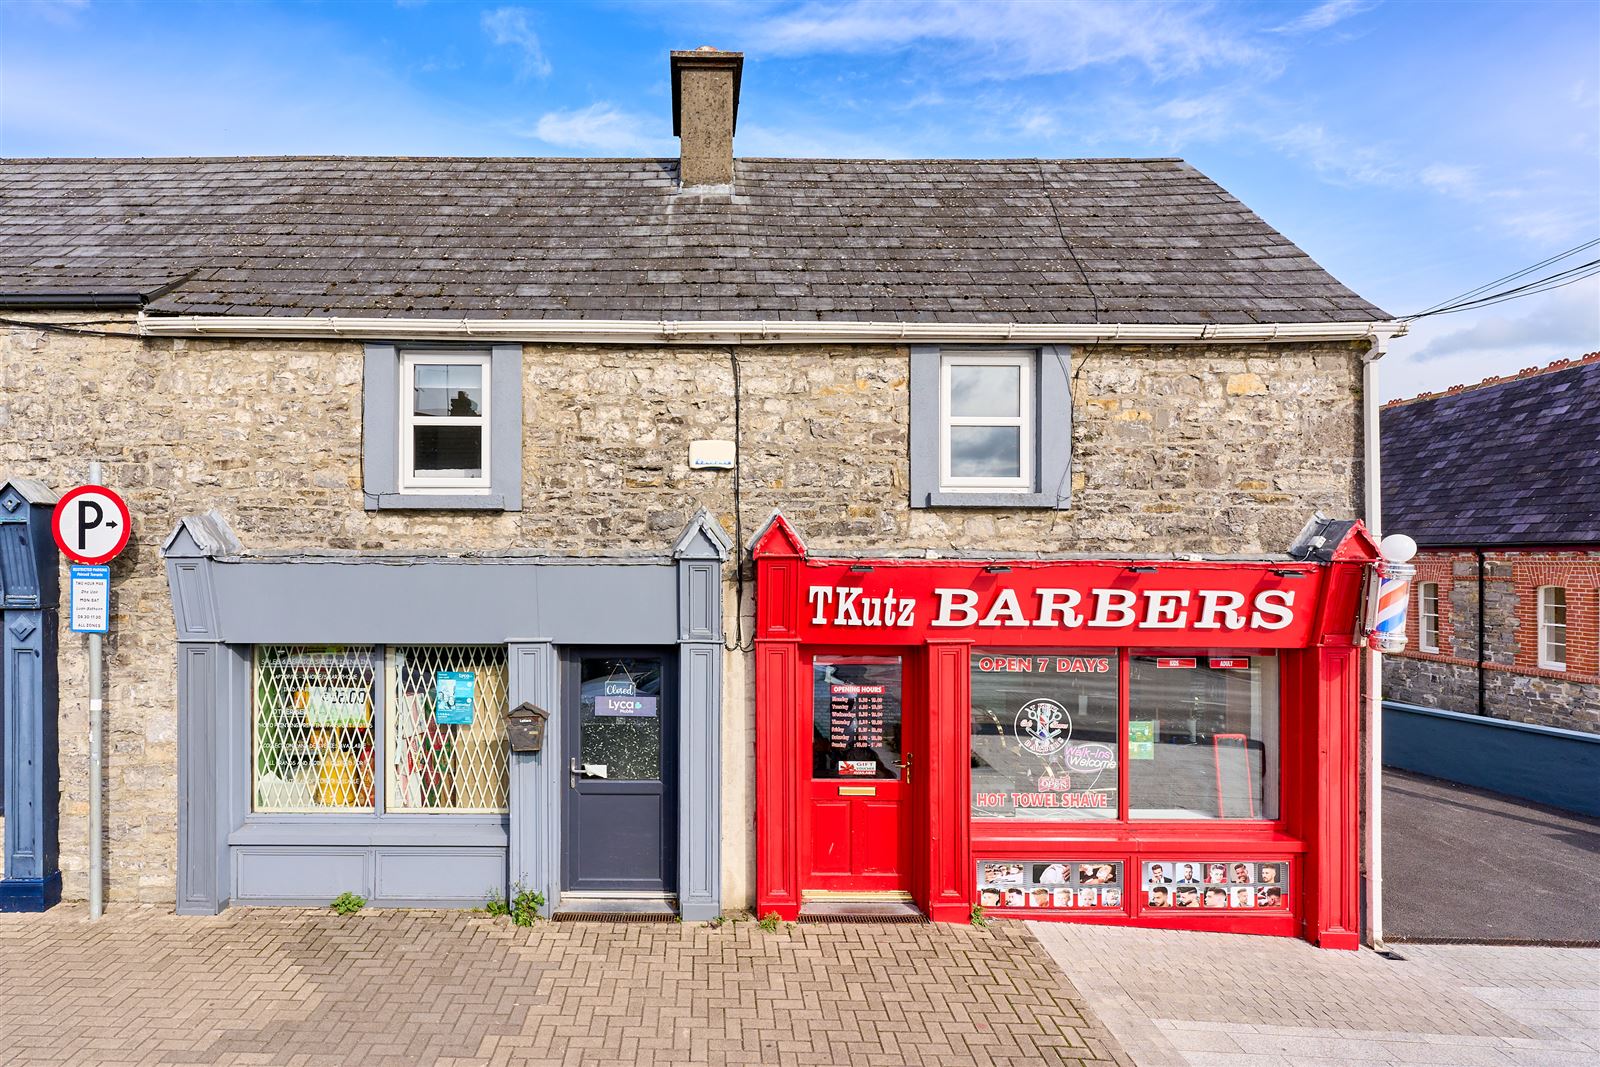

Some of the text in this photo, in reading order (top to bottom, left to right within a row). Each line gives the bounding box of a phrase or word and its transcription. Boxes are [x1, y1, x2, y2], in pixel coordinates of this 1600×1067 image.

[78, 500, 103, 550] P
[931, 588, 1296, 630] BARBERS
[979, 657, 1110, 672] OPEN 7 DAYS
[606, 684, 633, 695] Closed
[609, 700, 634, 710] Lyca
[1070, 756, 1116, 768] Welcome
[1041, 781, 1067, 789] OPEN
[976, 792, 1107, 808] HOT TOWEL SHAVE
